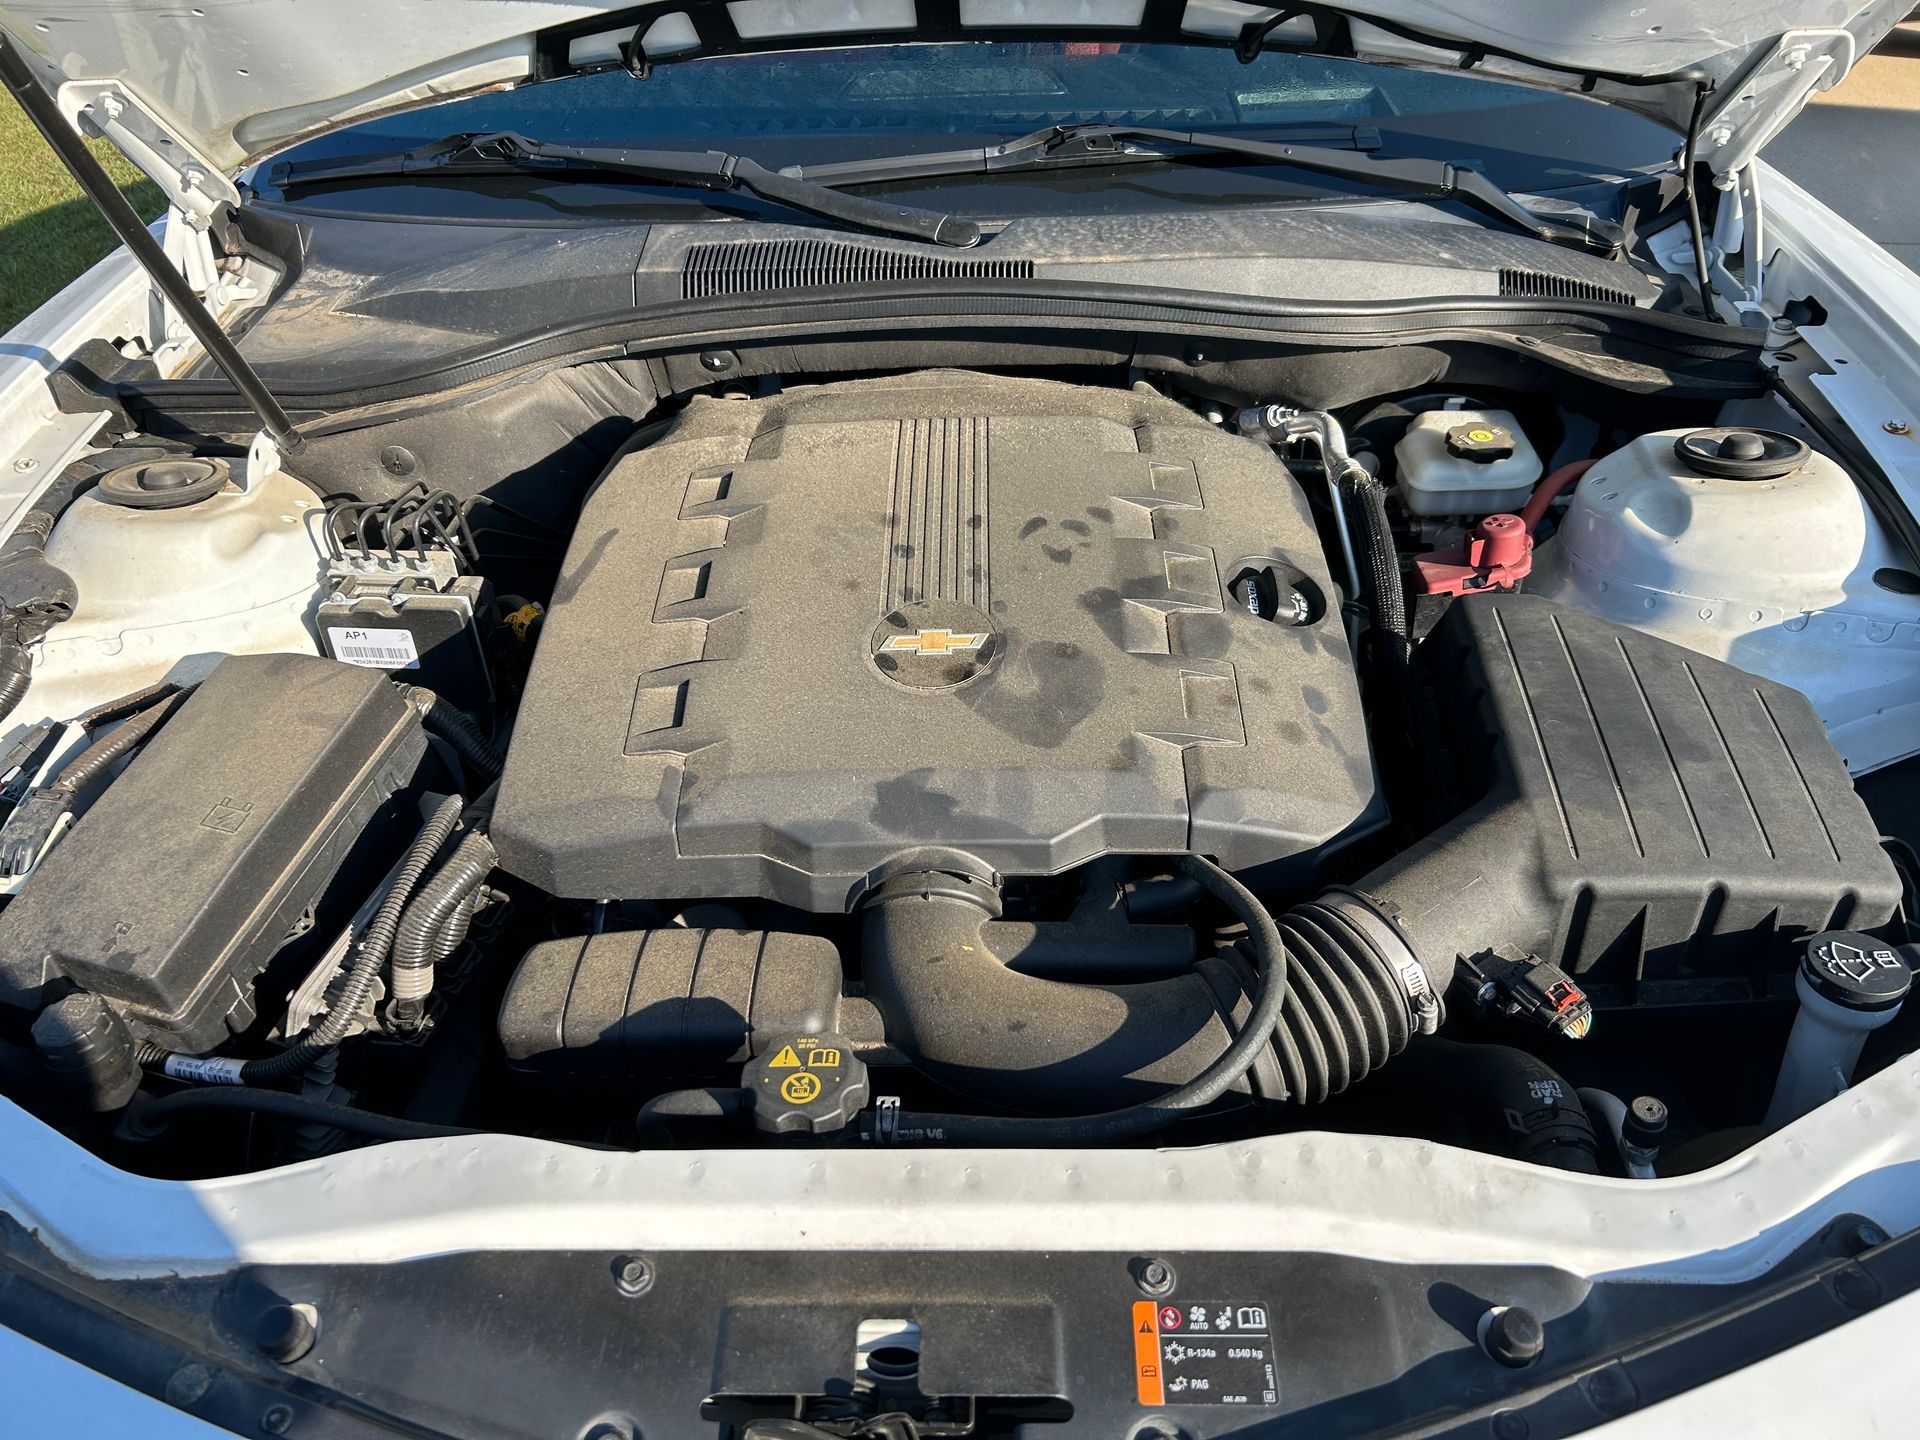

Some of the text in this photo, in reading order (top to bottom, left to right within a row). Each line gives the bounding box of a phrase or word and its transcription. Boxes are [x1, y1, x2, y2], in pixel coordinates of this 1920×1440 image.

[1247, 580, 1259, 615] dexos
[345, 631, 368, 640] AP1
[1530, 1088, 1563, 1098] RAD
[1190, 1322, 1209, 1331] AUTO
[1187, 1348, 1264, 1361] R-134a 0.540 kg
[1191, 1379, 1209, 1390] PAG
